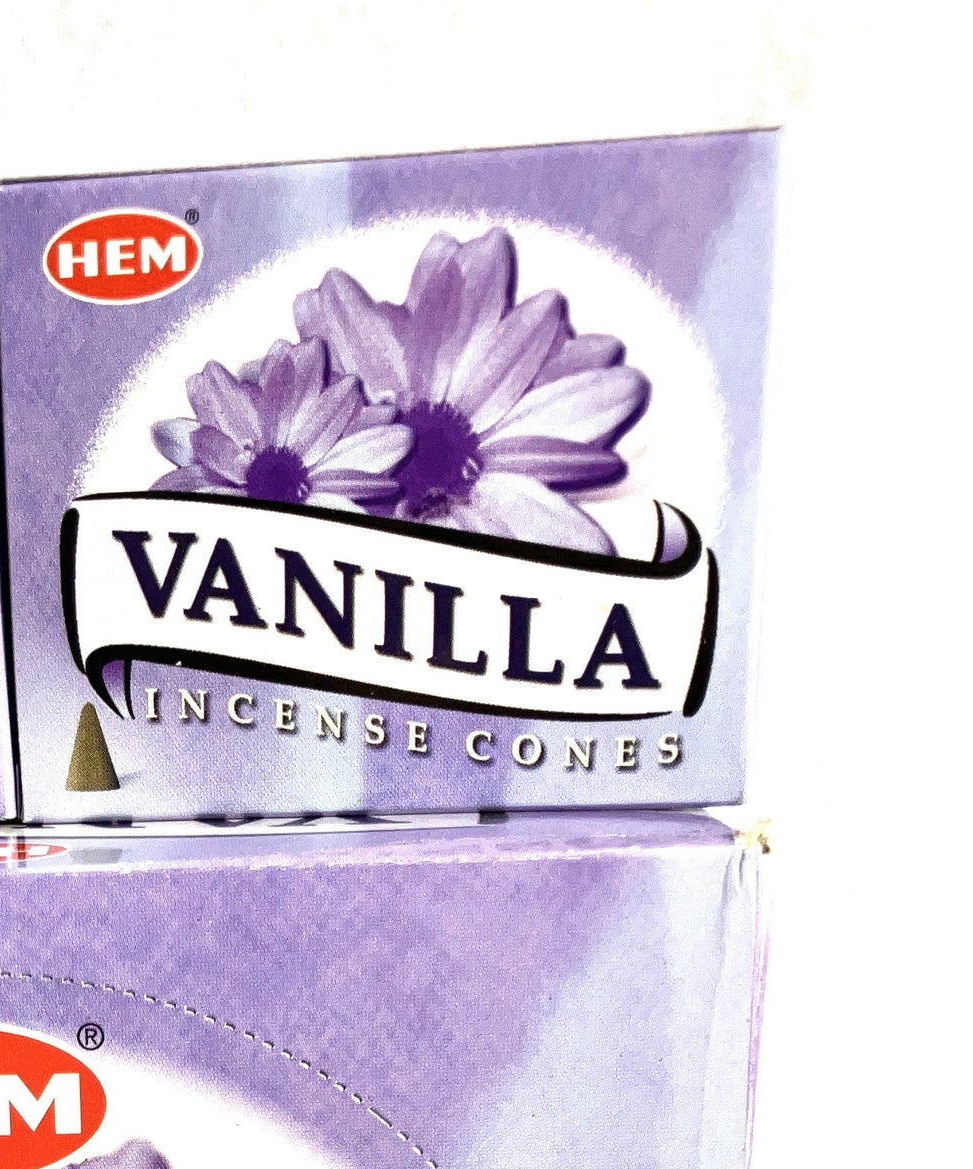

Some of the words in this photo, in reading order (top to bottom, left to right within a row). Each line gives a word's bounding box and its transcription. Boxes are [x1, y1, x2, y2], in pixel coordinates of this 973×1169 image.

[58, 236, 187, 279] HEM
[112, 529, 661, 692] VANILLA
[144, 687, 429, 754] INCENSE
[465, 729, 682, 769] CONES
